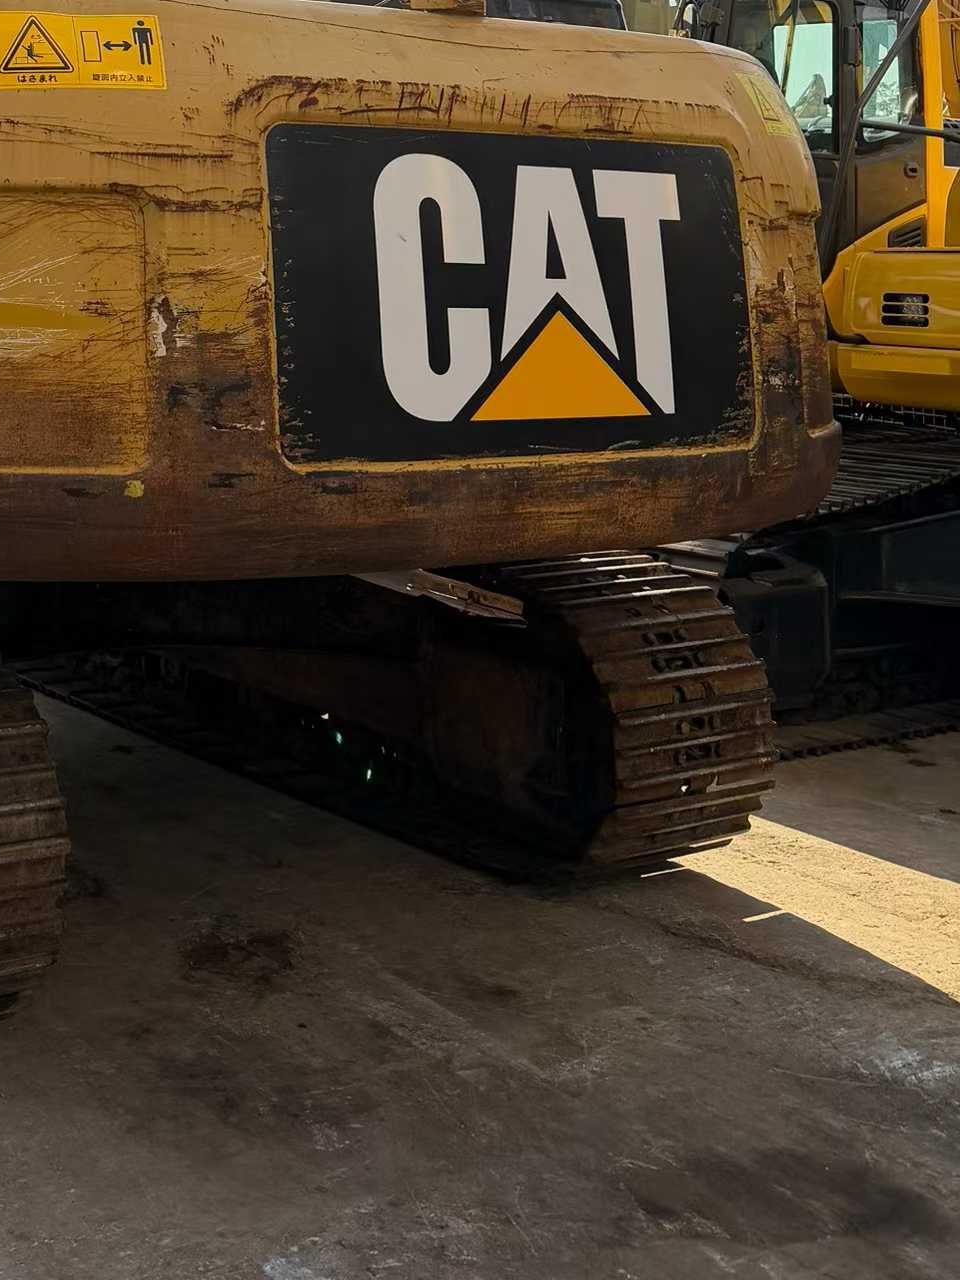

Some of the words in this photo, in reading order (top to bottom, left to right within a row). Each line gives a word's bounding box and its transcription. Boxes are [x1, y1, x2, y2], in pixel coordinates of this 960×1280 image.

[17, 74, 58, 83] はさまれ
[373, 153, 681, 422] CAT
